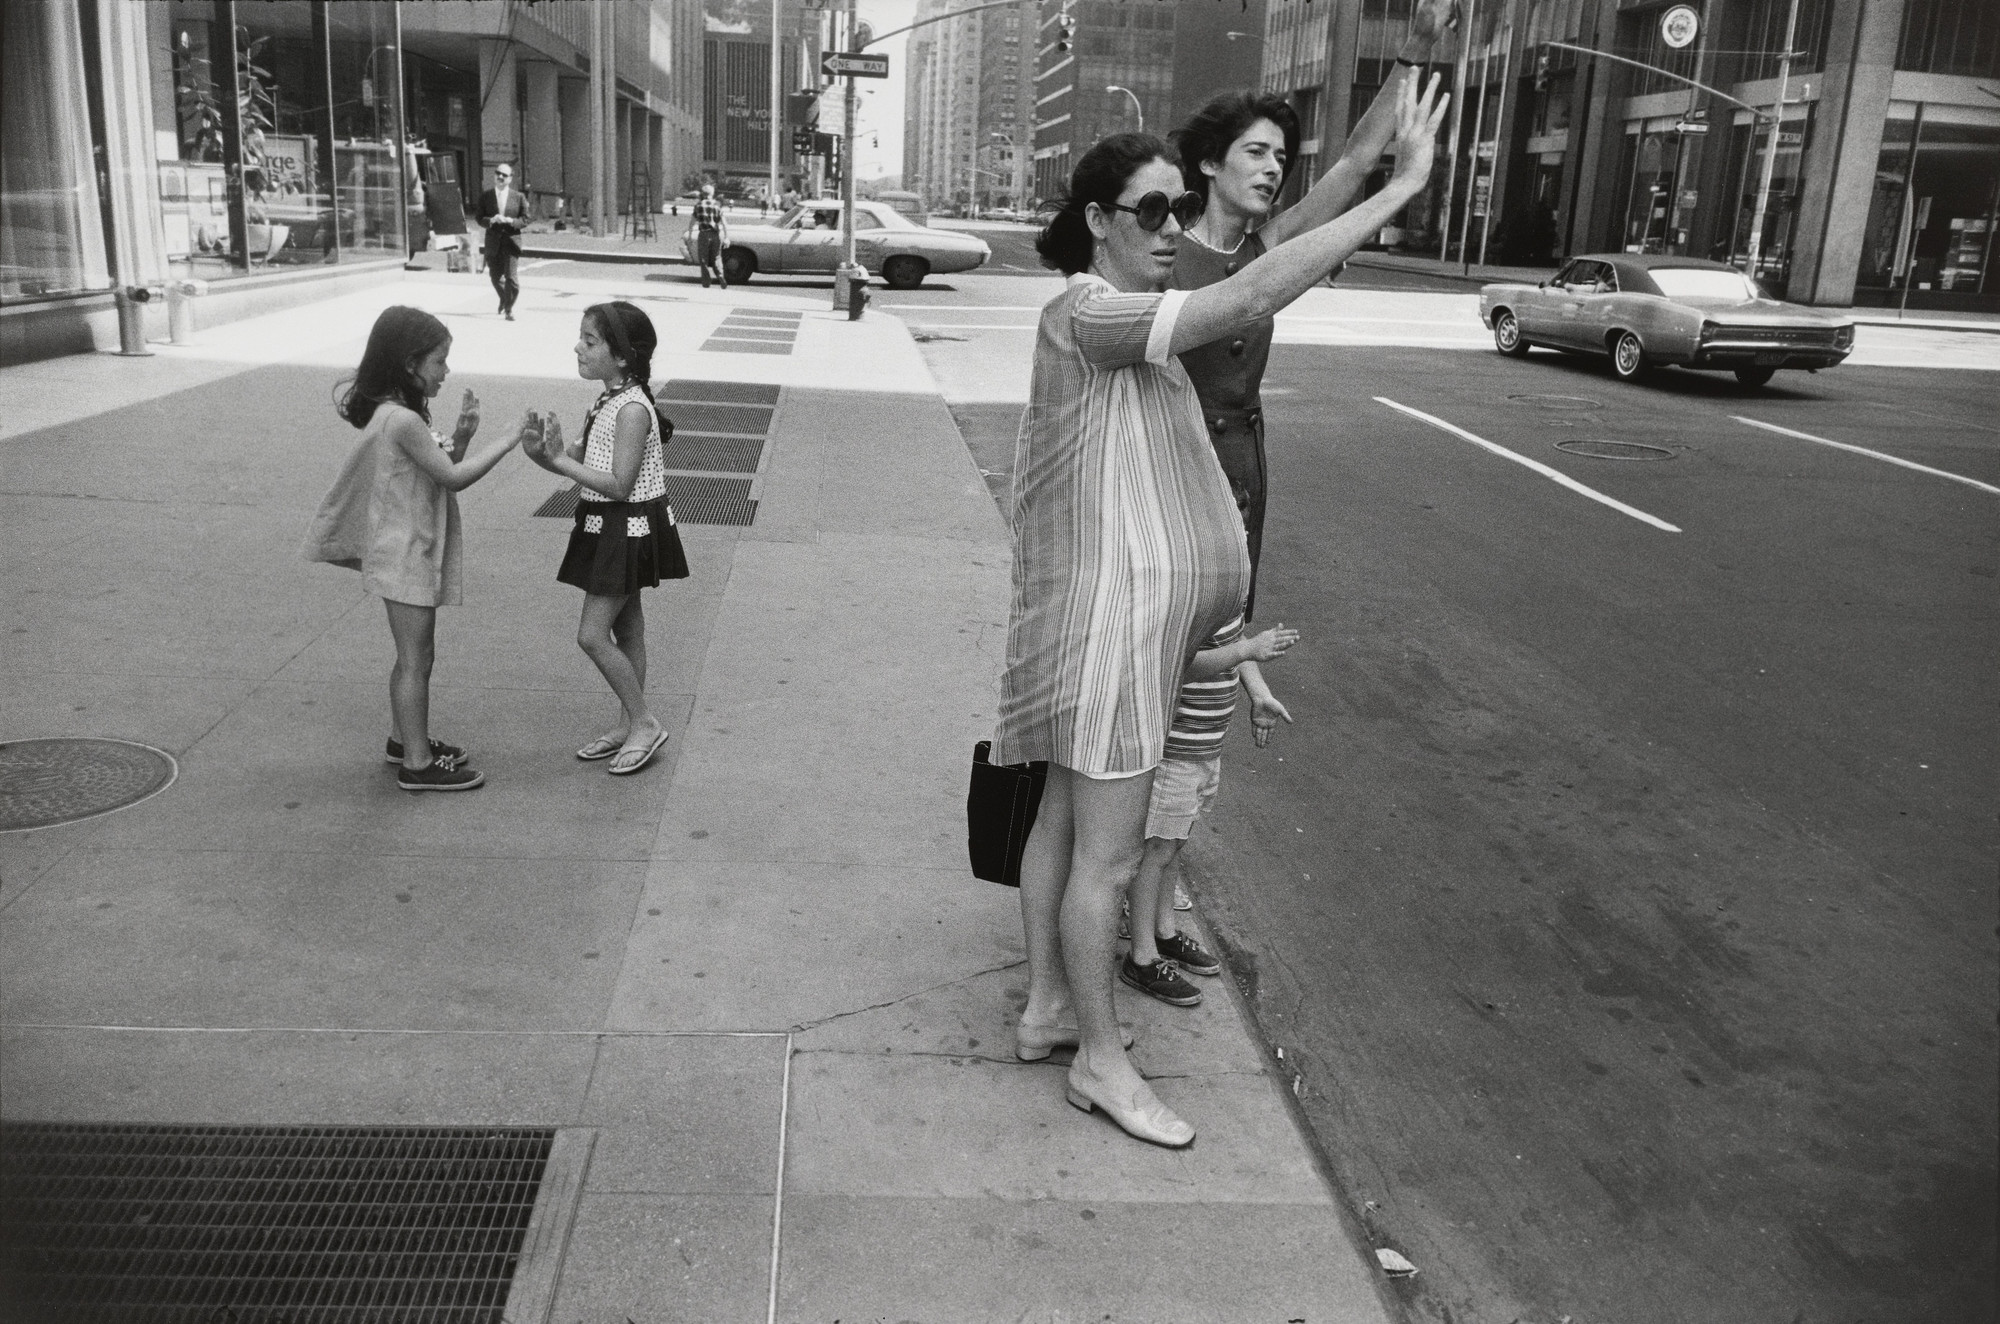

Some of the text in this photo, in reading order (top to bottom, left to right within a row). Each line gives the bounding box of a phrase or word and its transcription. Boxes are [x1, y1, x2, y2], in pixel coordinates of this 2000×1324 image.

[830, 59, 883, 71] ONE WAY
[728, 95, 747, 106] THE
[727, 107, 782, 119] NEW YO
[748, 121, 783, 131] HILT
[265, 155, 296, 174] rge
